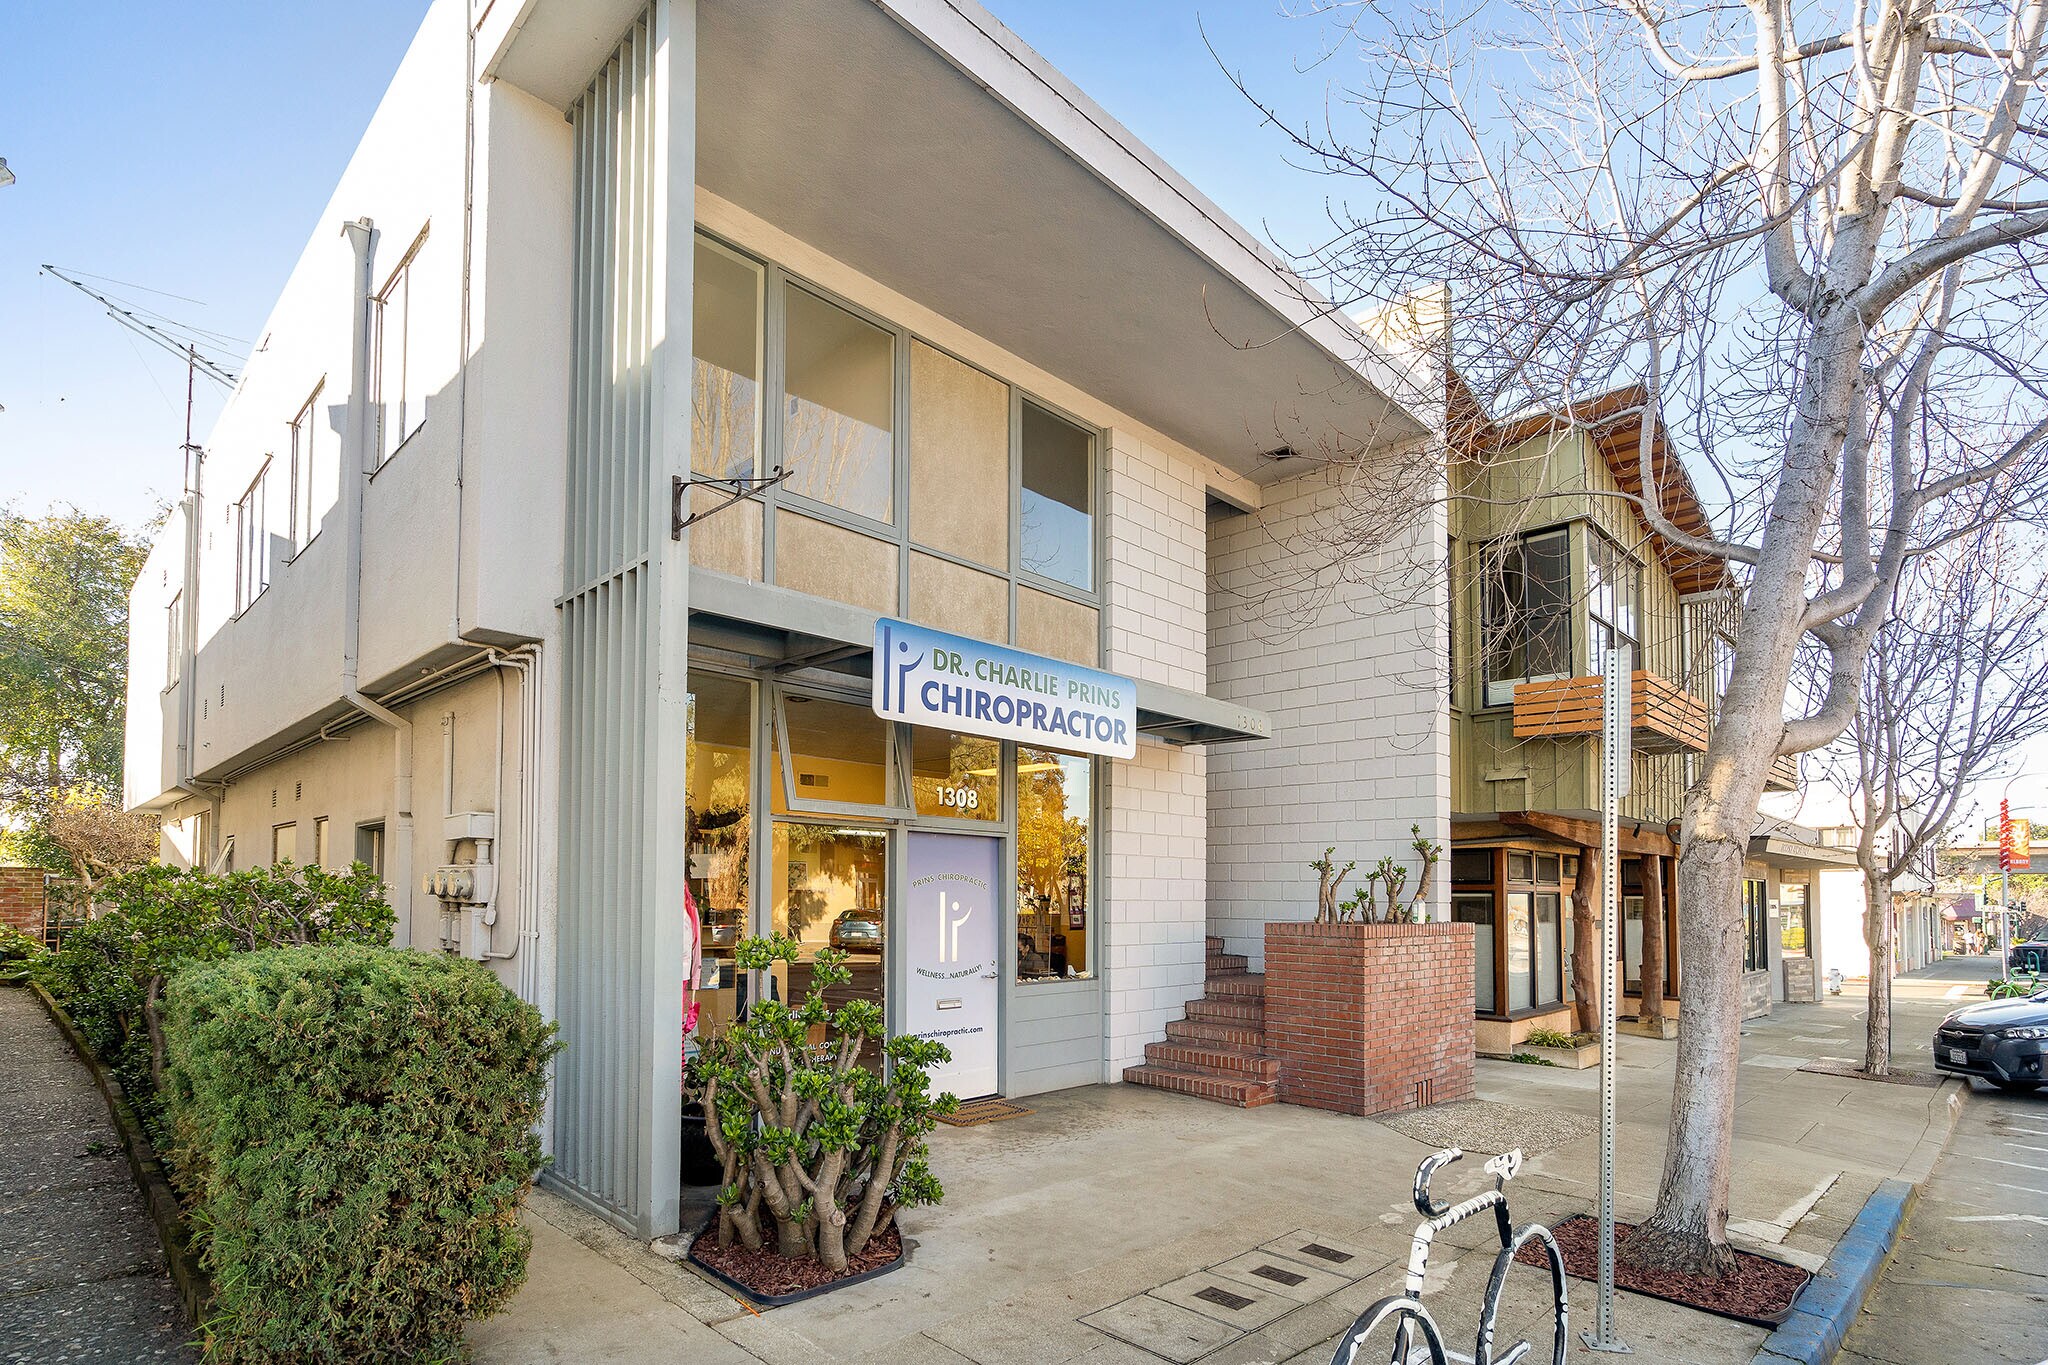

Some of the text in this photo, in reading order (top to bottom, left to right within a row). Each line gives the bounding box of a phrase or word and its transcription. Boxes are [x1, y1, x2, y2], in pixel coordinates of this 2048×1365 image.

[932, 648, 1121, 710] DR. CHARLIE PRINS
[920, 680, 1128, 746] CHIROPRACTOR
[936, 786, 978, 810] 1308
[912, 872, 989, 890] PRINS CHIROPRACTIC
